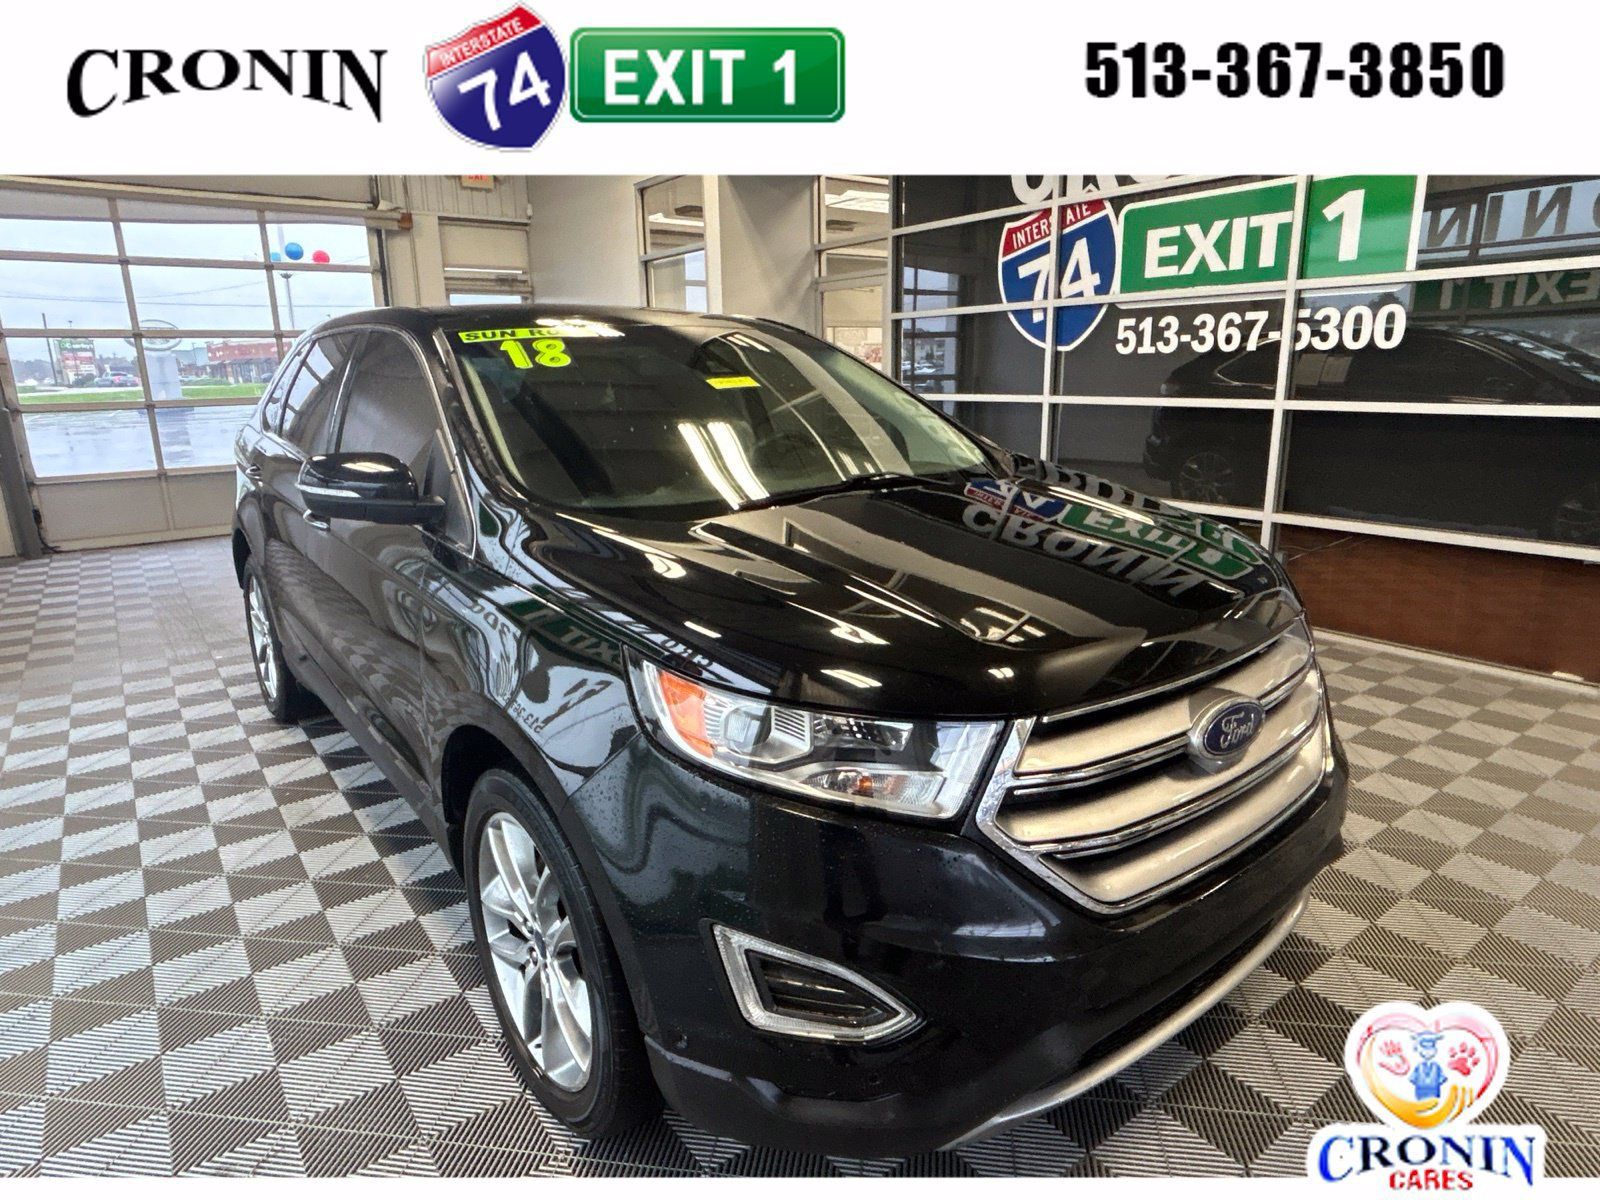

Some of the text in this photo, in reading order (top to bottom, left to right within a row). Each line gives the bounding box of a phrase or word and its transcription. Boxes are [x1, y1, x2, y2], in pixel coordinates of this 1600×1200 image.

[1012, 203, 1092, 250] INTERATE
[1144, 187, 1367, 279] EXIT 1
[1017, 237, 1101, 324] 74
[465, 331, 516, 341] SUN
[1115, 302, 1406, 355] 513-367-5300
[501, 338, 571, 369] 18
[1220, 711, 1256, 749] Ford
